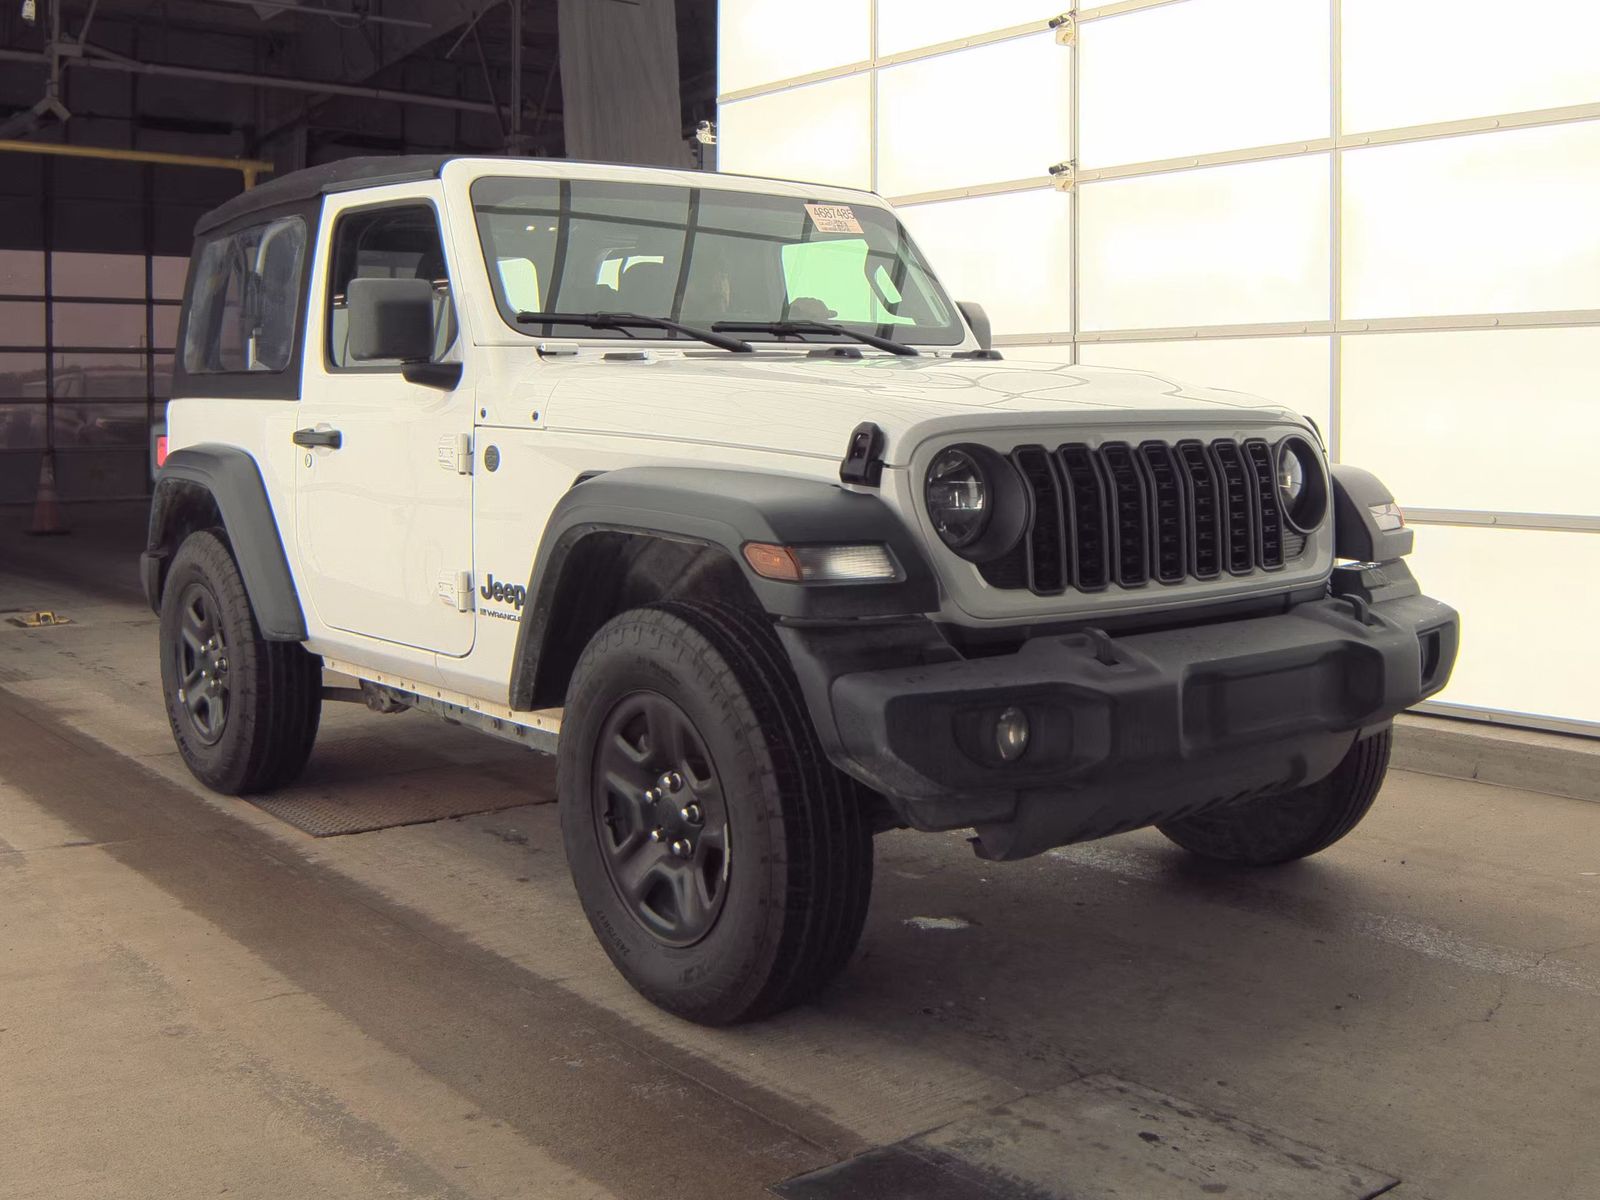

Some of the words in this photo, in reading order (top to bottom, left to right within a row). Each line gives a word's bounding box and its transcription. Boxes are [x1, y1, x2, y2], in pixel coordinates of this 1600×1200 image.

[813, 207, 855, 220] 4687485
[480, 573, 526, 611] Jeep
[487, 609, 522, 622] WRANGLE
